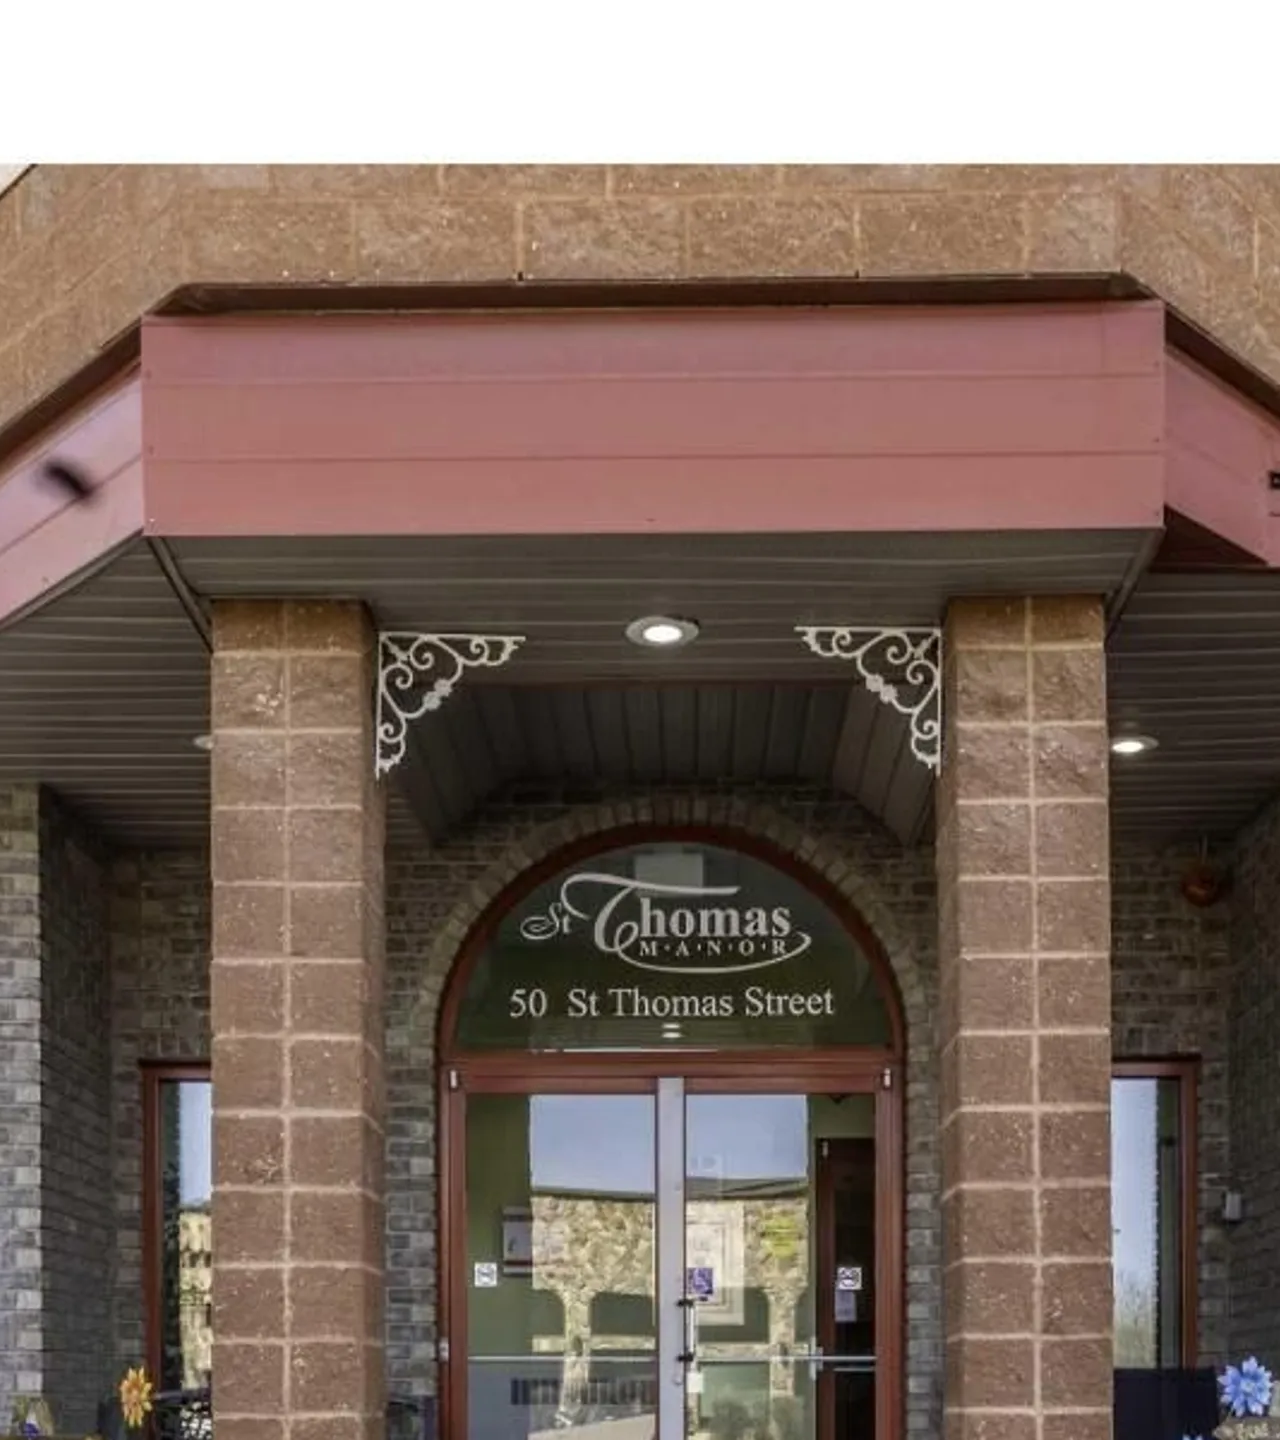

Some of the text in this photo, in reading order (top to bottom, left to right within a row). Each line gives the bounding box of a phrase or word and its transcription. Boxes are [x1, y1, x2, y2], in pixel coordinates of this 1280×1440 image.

[561, 872, 793, 952] Thomas
[509, 986, 835, 1018] 50 St Thomas Street
